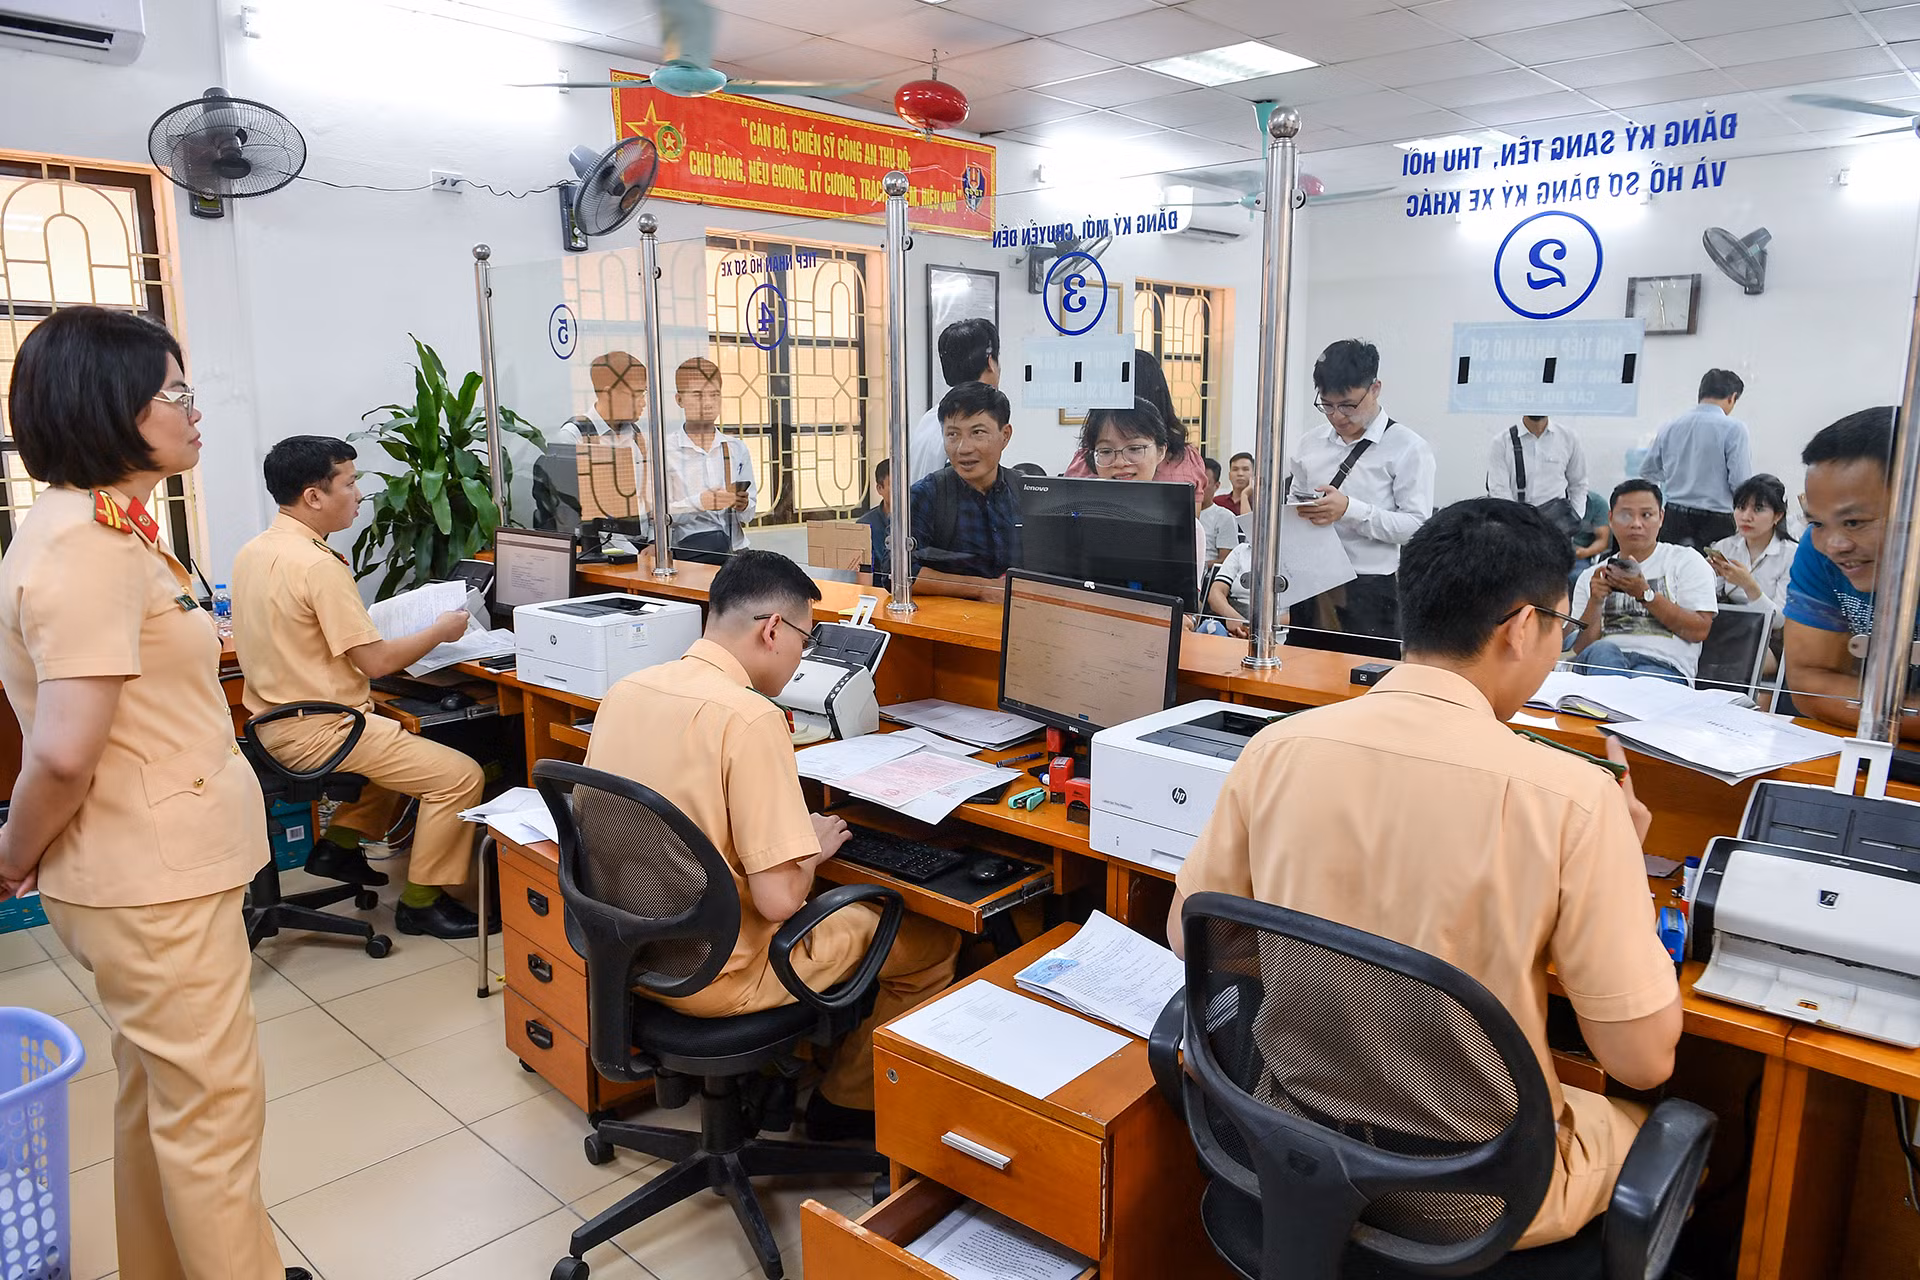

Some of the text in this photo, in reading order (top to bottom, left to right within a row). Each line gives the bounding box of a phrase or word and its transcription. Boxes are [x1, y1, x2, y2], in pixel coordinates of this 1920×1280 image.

[773, 122, 790, 155] BỘ,
[792, 125, 821, 157] CHIẾN
[823, 132, 836, 159] SỸ
[837, 134, 862, 164] CÔNG
[864, 143, 878, 167] AN
[878, 138, 896, 169] THỦ
[689, 143, 711, 178] CHỦ
[714, 151, 747, 185] ĐỘNG,
[748, 156, 769, 185] NÊU
[772, 163, 808, 194] GƯƠNG,
[810, 162, 822, 193] KỶ
[824, 171, 858, 200] CƯƠNG,
[1023, 484, 1049, 492] lenovo
[1171, 786, 1187, 805] hp
